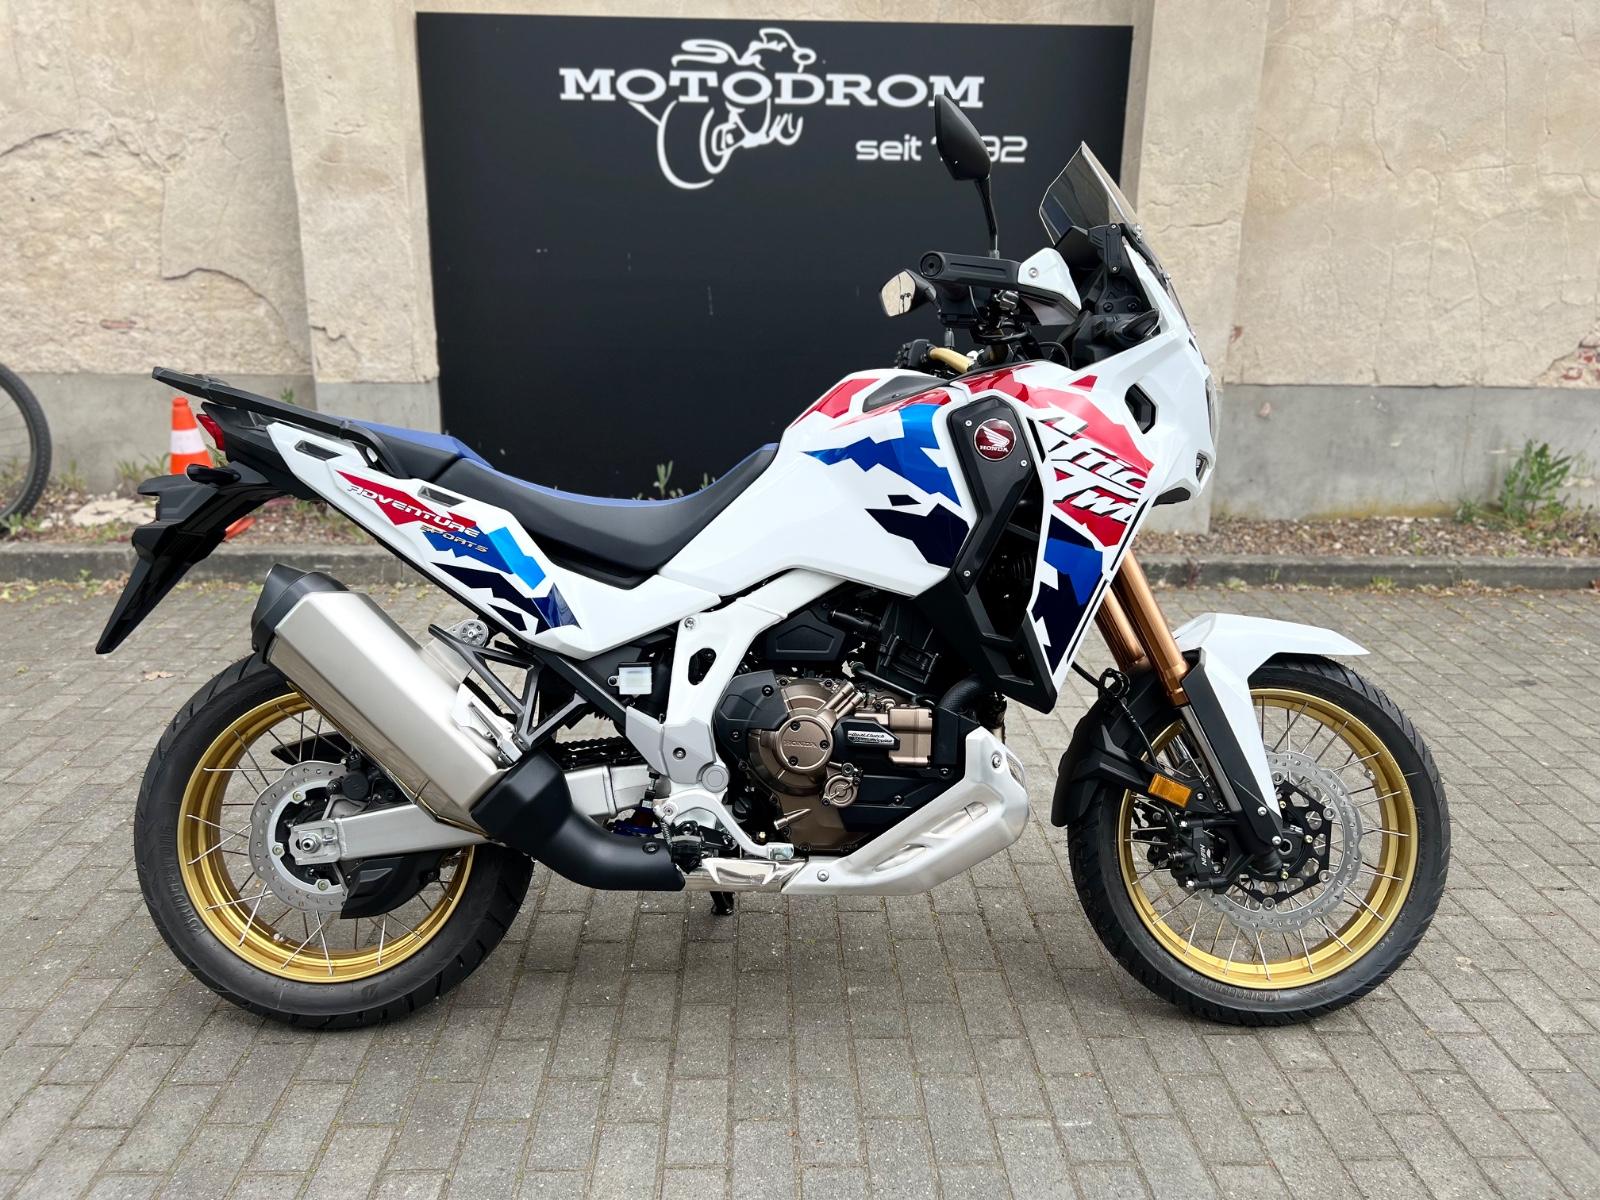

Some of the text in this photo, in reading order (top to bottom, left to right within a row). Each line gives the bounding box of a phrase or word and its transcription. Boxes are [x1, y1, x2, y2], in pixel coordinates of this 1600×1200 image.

[559, 67, 984, 109] MOTODROM
[855, 133, 1028, 163] seit 92
[979, 445, 1008, 453] HONDA
[347, 485, 481, 538] ADVENTURE
[419, 524, 489, 554] SPORTS
